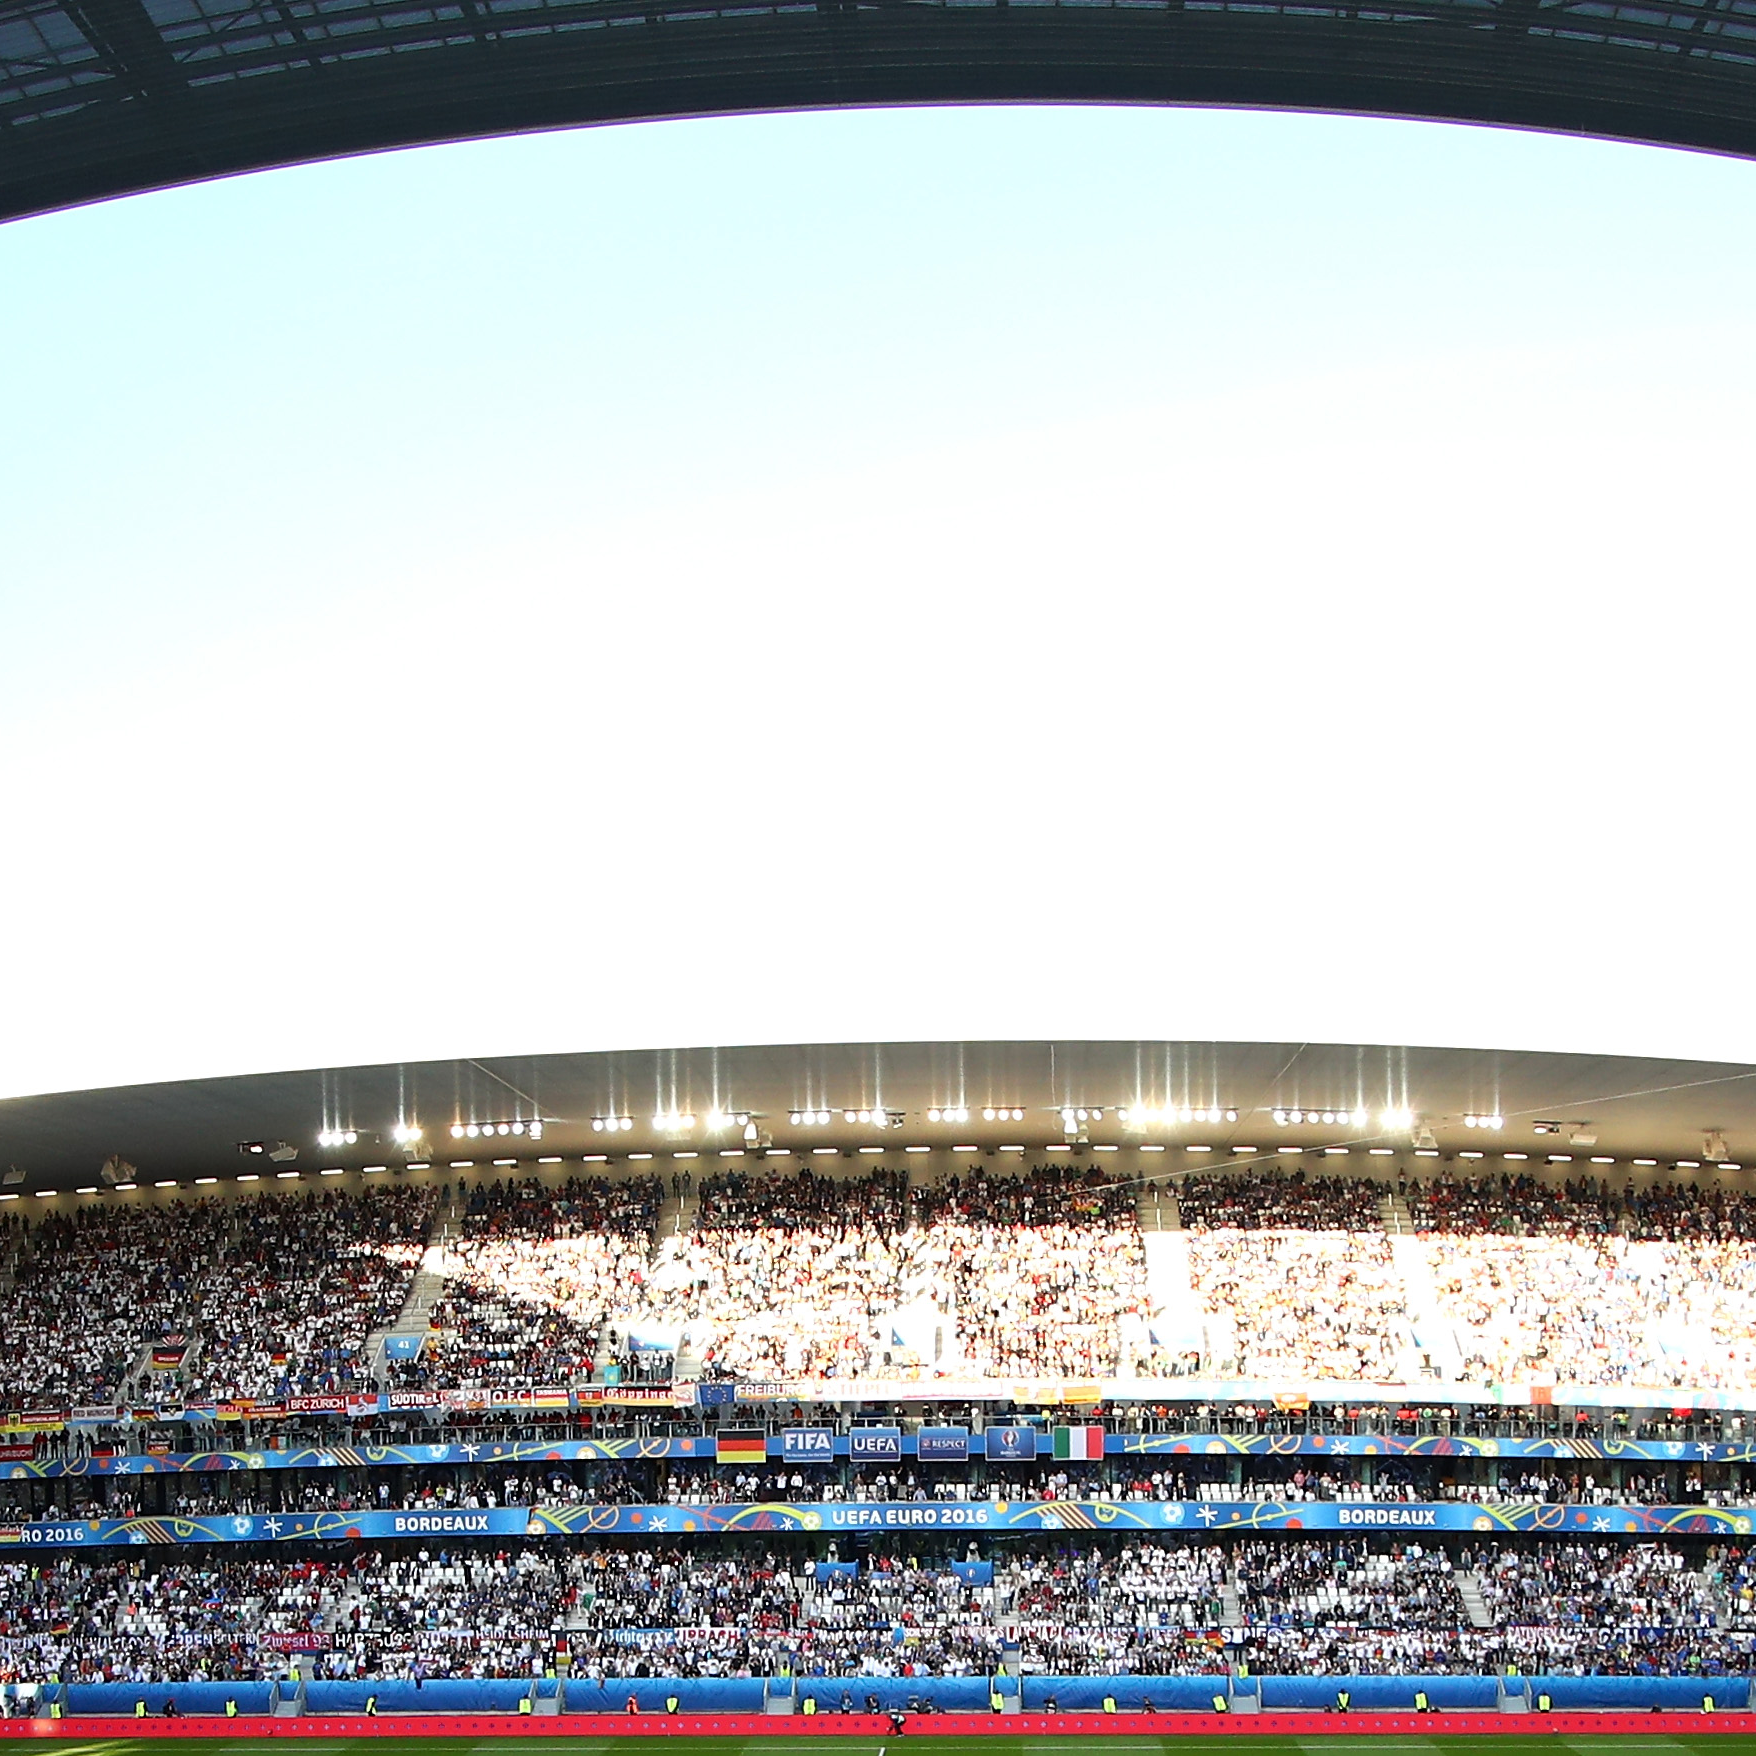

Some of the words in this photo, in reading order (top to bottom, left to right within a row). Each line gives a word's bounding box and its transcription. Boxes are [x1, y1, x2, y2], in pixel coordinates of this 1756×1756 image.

[606, 1387, 673, 1402] Göppinge
[784, 1433, 831, 1450] FIFA
[853, 1437, 897, 1452] UEFA
[931, 1440, 966, 1449] RESPECT
[394, 1516, 489, 1533] BORDEAUX
[831, 1510, 882, 1525] UEFA
[885, 1510, 937, 1524] EURO
[940, 1509, 989, 1524] 2016
[1338, 1508, 1436, 1526] BORDEAUX
[44, 1527, 85, 1542] 2016
